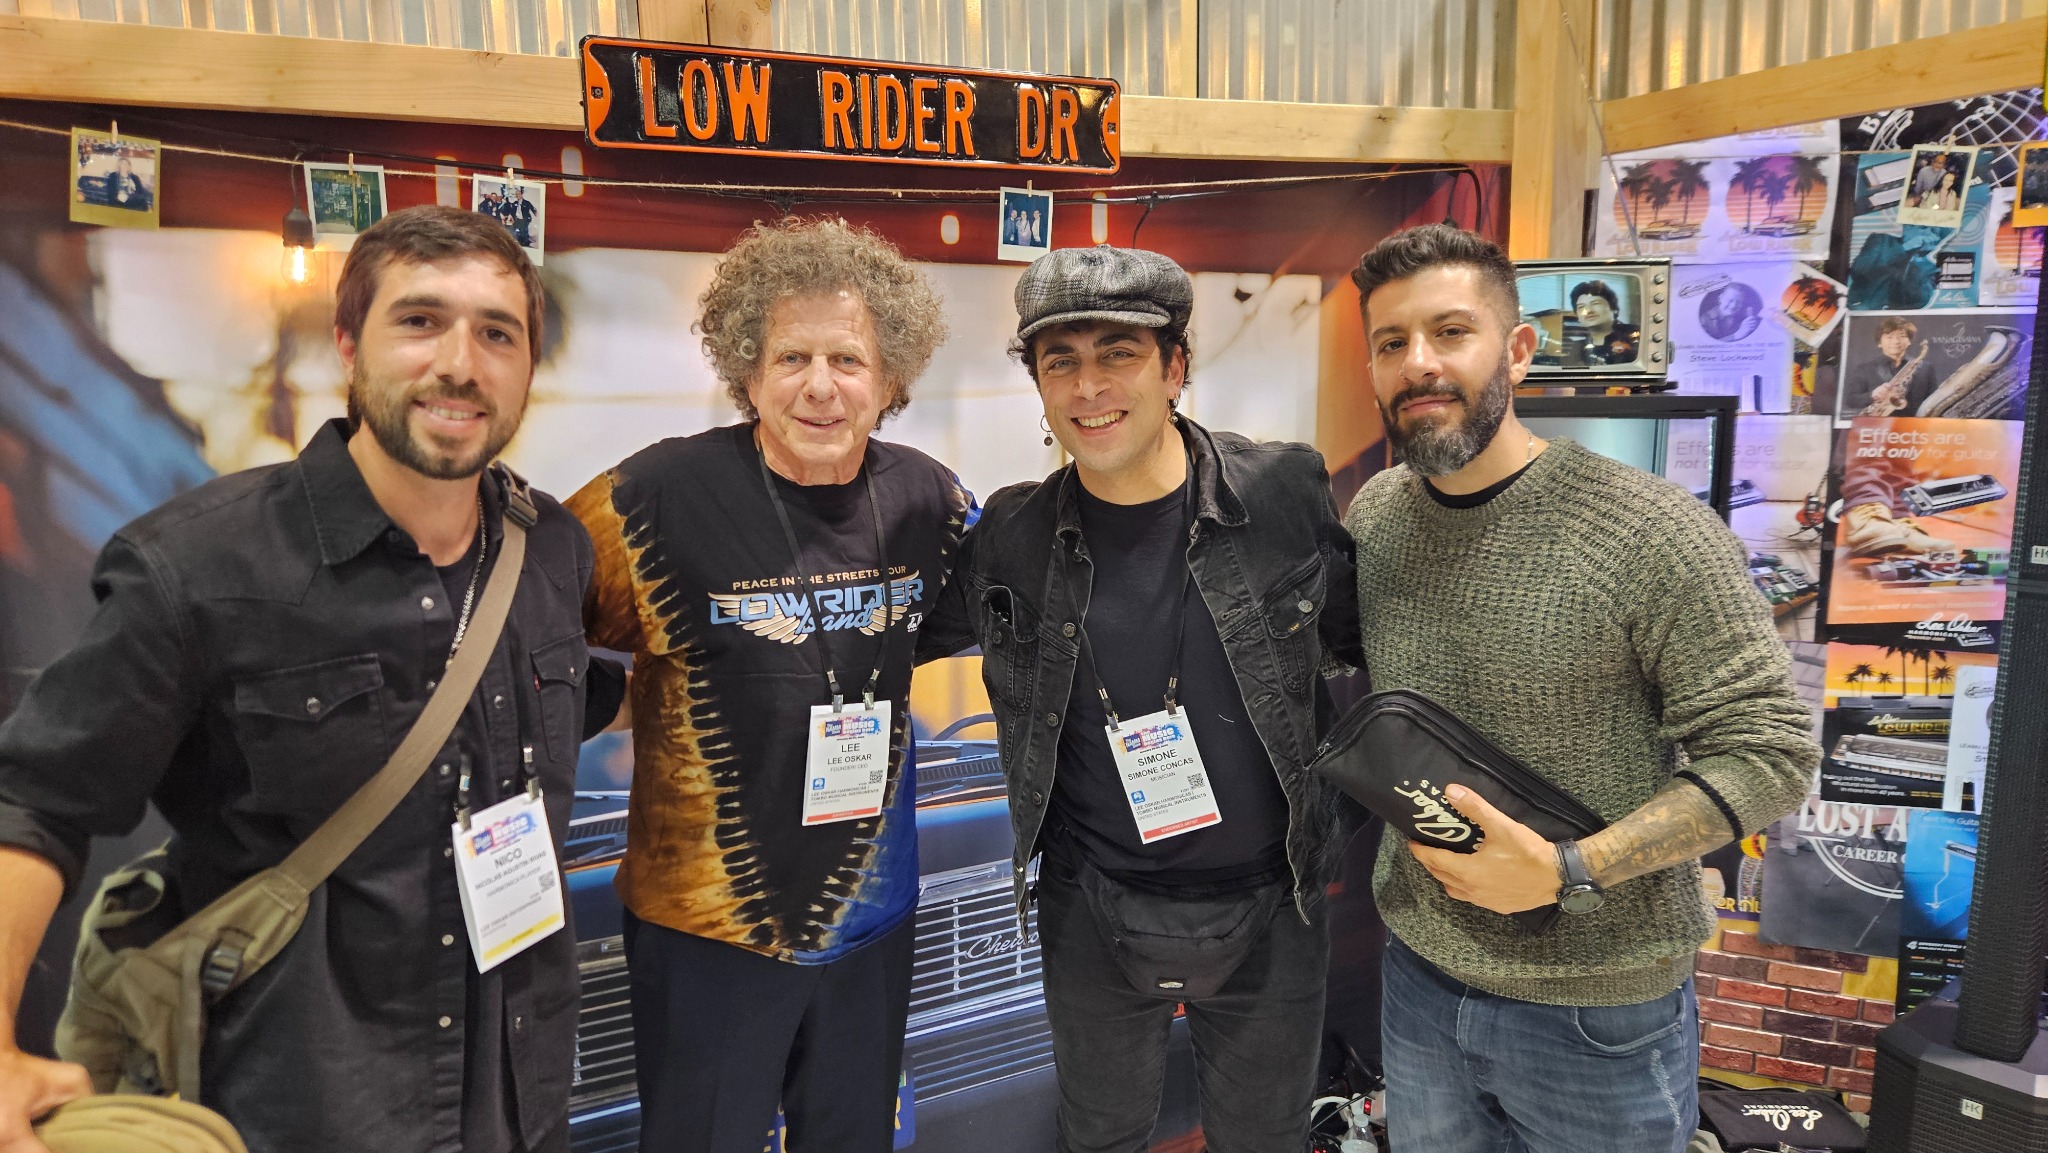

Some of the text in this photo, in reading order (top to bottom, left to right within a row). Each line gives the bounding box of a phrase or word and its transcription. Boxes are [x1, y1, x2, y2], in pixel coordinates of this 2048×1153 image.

[638, 55, 1079, 163] LOW RIDER DR
[1690, 353, 1765, 363] Steve Lockwood
[1858, 428, 1966, 446] Effects are
[1745, 443, 1776, 457] are
[1855, 446, 1885, 458] not
[1887, 446, 1924, 461] only
[1926, 446, 1948, 459] for
[1674, 458, 1700, 470] not
[732, 577, 779, 591] PEACE
[781, 576, 796, 586] IN
[826, 568, 880, 584] STREETS
[1915, 612, 1988, 633] Lee Oskar
[841, 743, 861, 753] LEE
[827, 754, 872, 765] LEE OSKAR
[1137, 749, 1178, 767] SIMONE
[1127, 757, 1194, 781] SIMONE CONCAS
[1150, 772, 1176, 782] MUSICIAN
[1797, 800, 1878, 840] LOST
[494, 847, 523, 870] NICO
[1832, 844, 1898, 864] CAREER
[1964, 1102, 1981, 1115] HK
[1743, 1107, 1823, 1131] Lee Oskar
